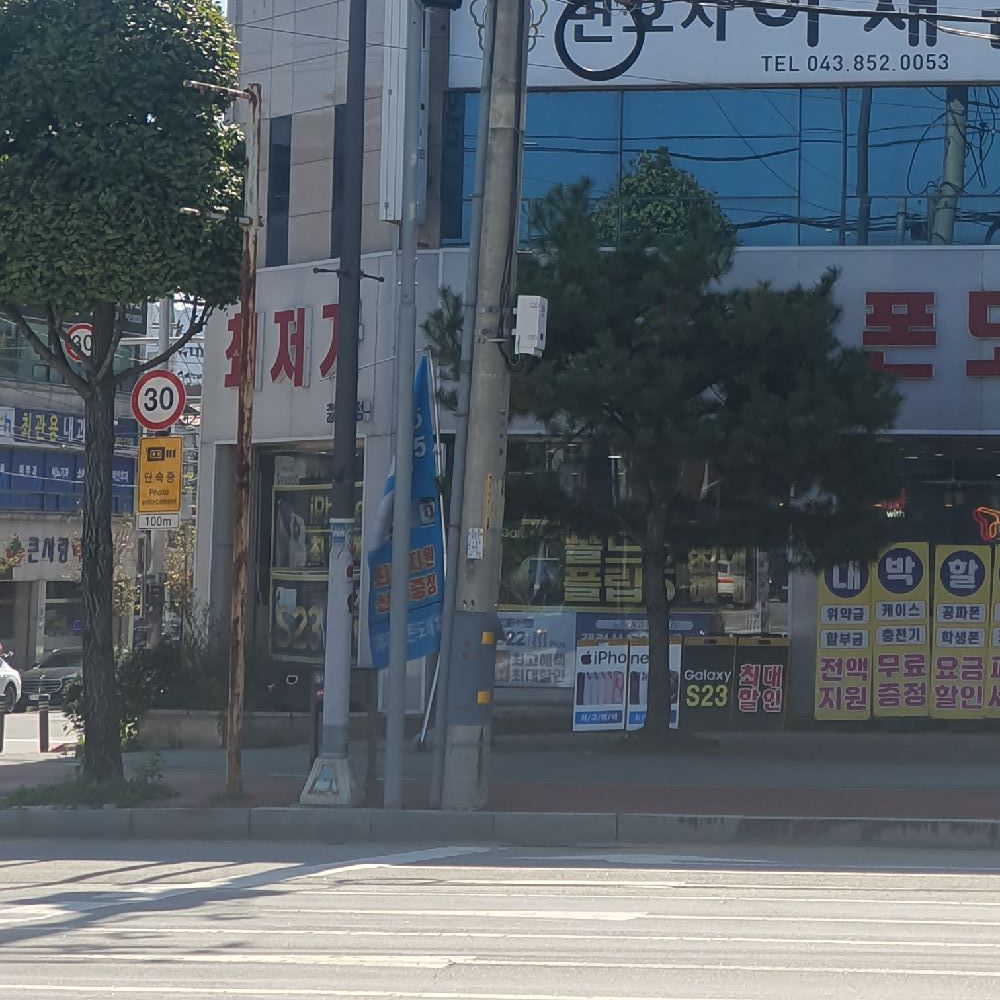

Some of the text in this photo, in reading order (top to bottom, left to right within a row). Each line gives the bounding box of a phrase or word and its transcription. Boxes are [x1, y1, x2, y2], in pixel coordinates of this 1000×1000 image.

[761, 54, 950, 73] TEL 043.852.0053
[143, 386, 174, 412] 30
[144, 471, 175, 484] 단속중
[149, 488, 169, 496] Photo
[145, 515, 172, 527] 100m
[885, 556, 916, 585] 박
[947, 559, 979, 589] 할
[827, 607, 865, 620] 위약금
[881, 602, 920, 618] 케이스
[881, 627, 920, 643] 충전기
[593, 650, 649, 666] iPhone
[820, 656, 868, 682] 전액
[877, 653, 926, 678] 무료
[935, 655, 984, 681] 요금
[684, 669, 732, 682] Galaxy
[739, 664, 784, 687] 최대
[686, 684, 728, 707] S23
[738, 688, 784, 712] 할인
[818, 684, 868, 711] 지원
[876, 681, 927, 708] 증정
[934, 684, 984, 710] 할인
